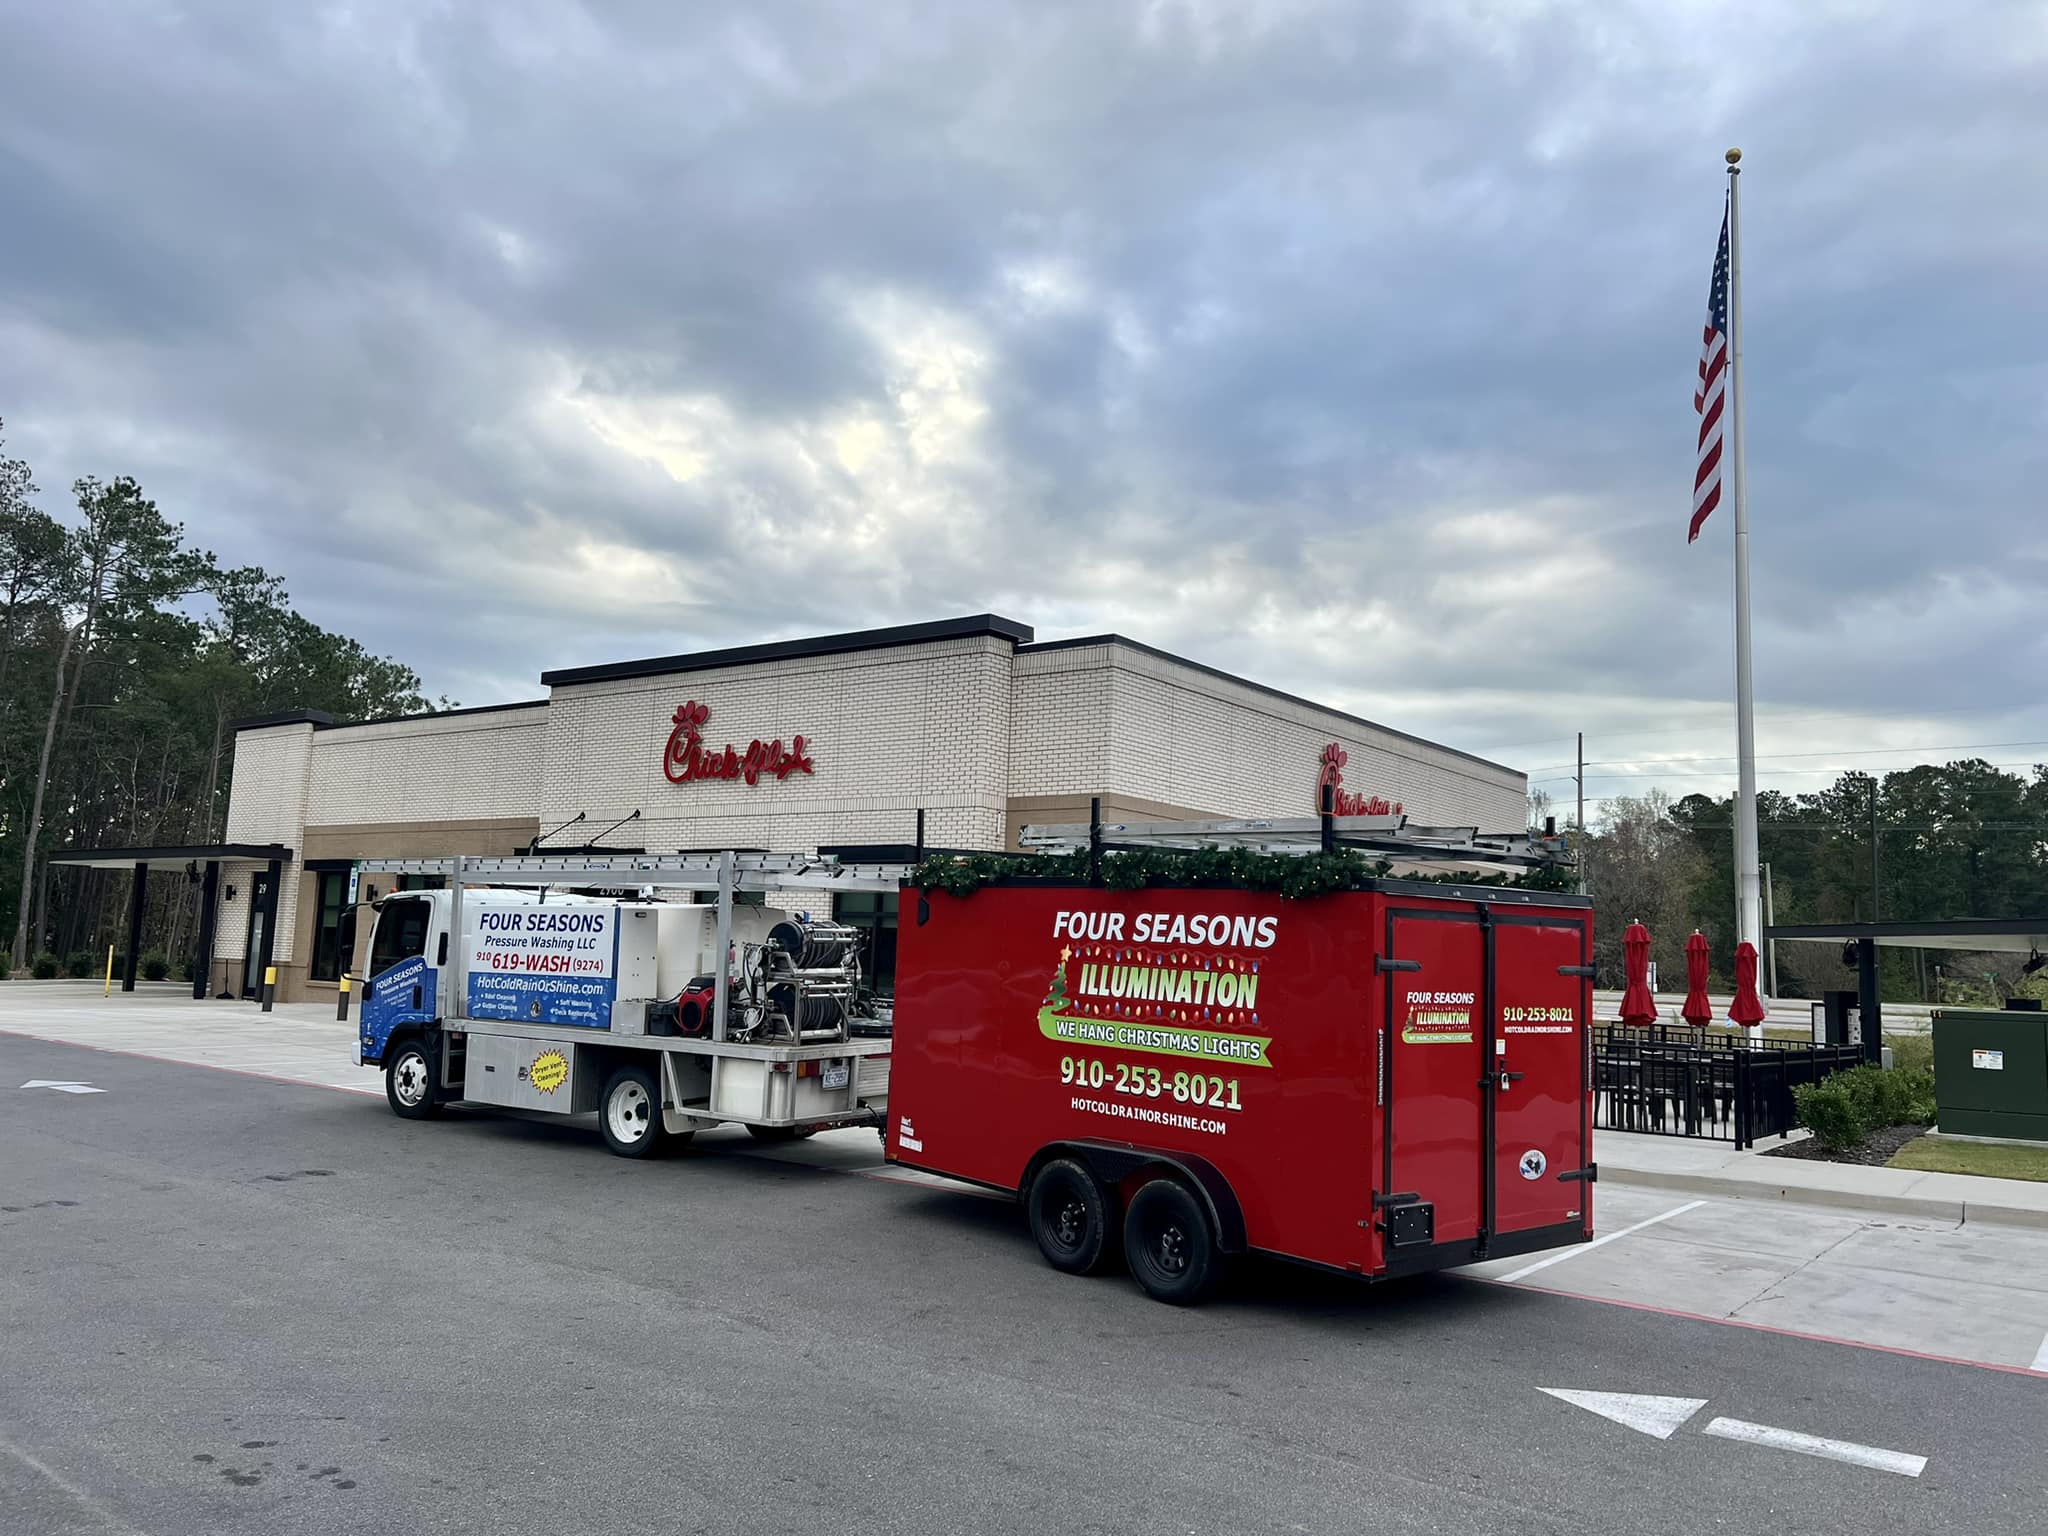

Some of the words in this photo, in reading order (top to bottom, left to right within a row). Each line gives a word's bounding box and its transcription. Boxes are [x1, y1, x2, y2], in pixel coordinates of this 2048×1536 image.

[664, 718, 814, 785] Chick-fil-A
[479, 913, 522, 931] FOUR
[526, 914, 605, 932] SEASONS
[1053, 911, 1126, 941] FOUR
[1132, 913, 1279, 948] SEASONS
[485, 935, 528, 948] Pressure
[531, 937, 574, 951] Washing
[577, 938, 596, 949] LLC
[476, 952, 491, 961] 910
[492, 953, 571, 972] 619-WASH
[573, 958, 604, 973] (9274)
[376, 977, 393, 990] FOUR
[393, 962, 423, 982] SEASONS
[477, 976, 604, 994] HotColdRainOrShine.com
[1079, 963, 1259, 1009] ILLUMINATION
[1406, 991, 1432, 1004] FOUR
[1433, 992, 1475, 1004] SEASONS
[1416, 1011, 1470, 1025] ILLUMINATION
[1503, 1006, 1574, 1021] 910-253-8021
[1056, 1021, 1076, 1037] WE
[1079, 1023, 1114, 1042] HANG
[1118, 1029, 1199, 1052] CHRISTMAS
[1203, 1037, 1261, 1060] LIGHTS
[1060, 1056, 1242, 1111] 910-253-8021
[1071, 1097, 1227, 1135] HOTCOLDRAINORSHINE.COM
